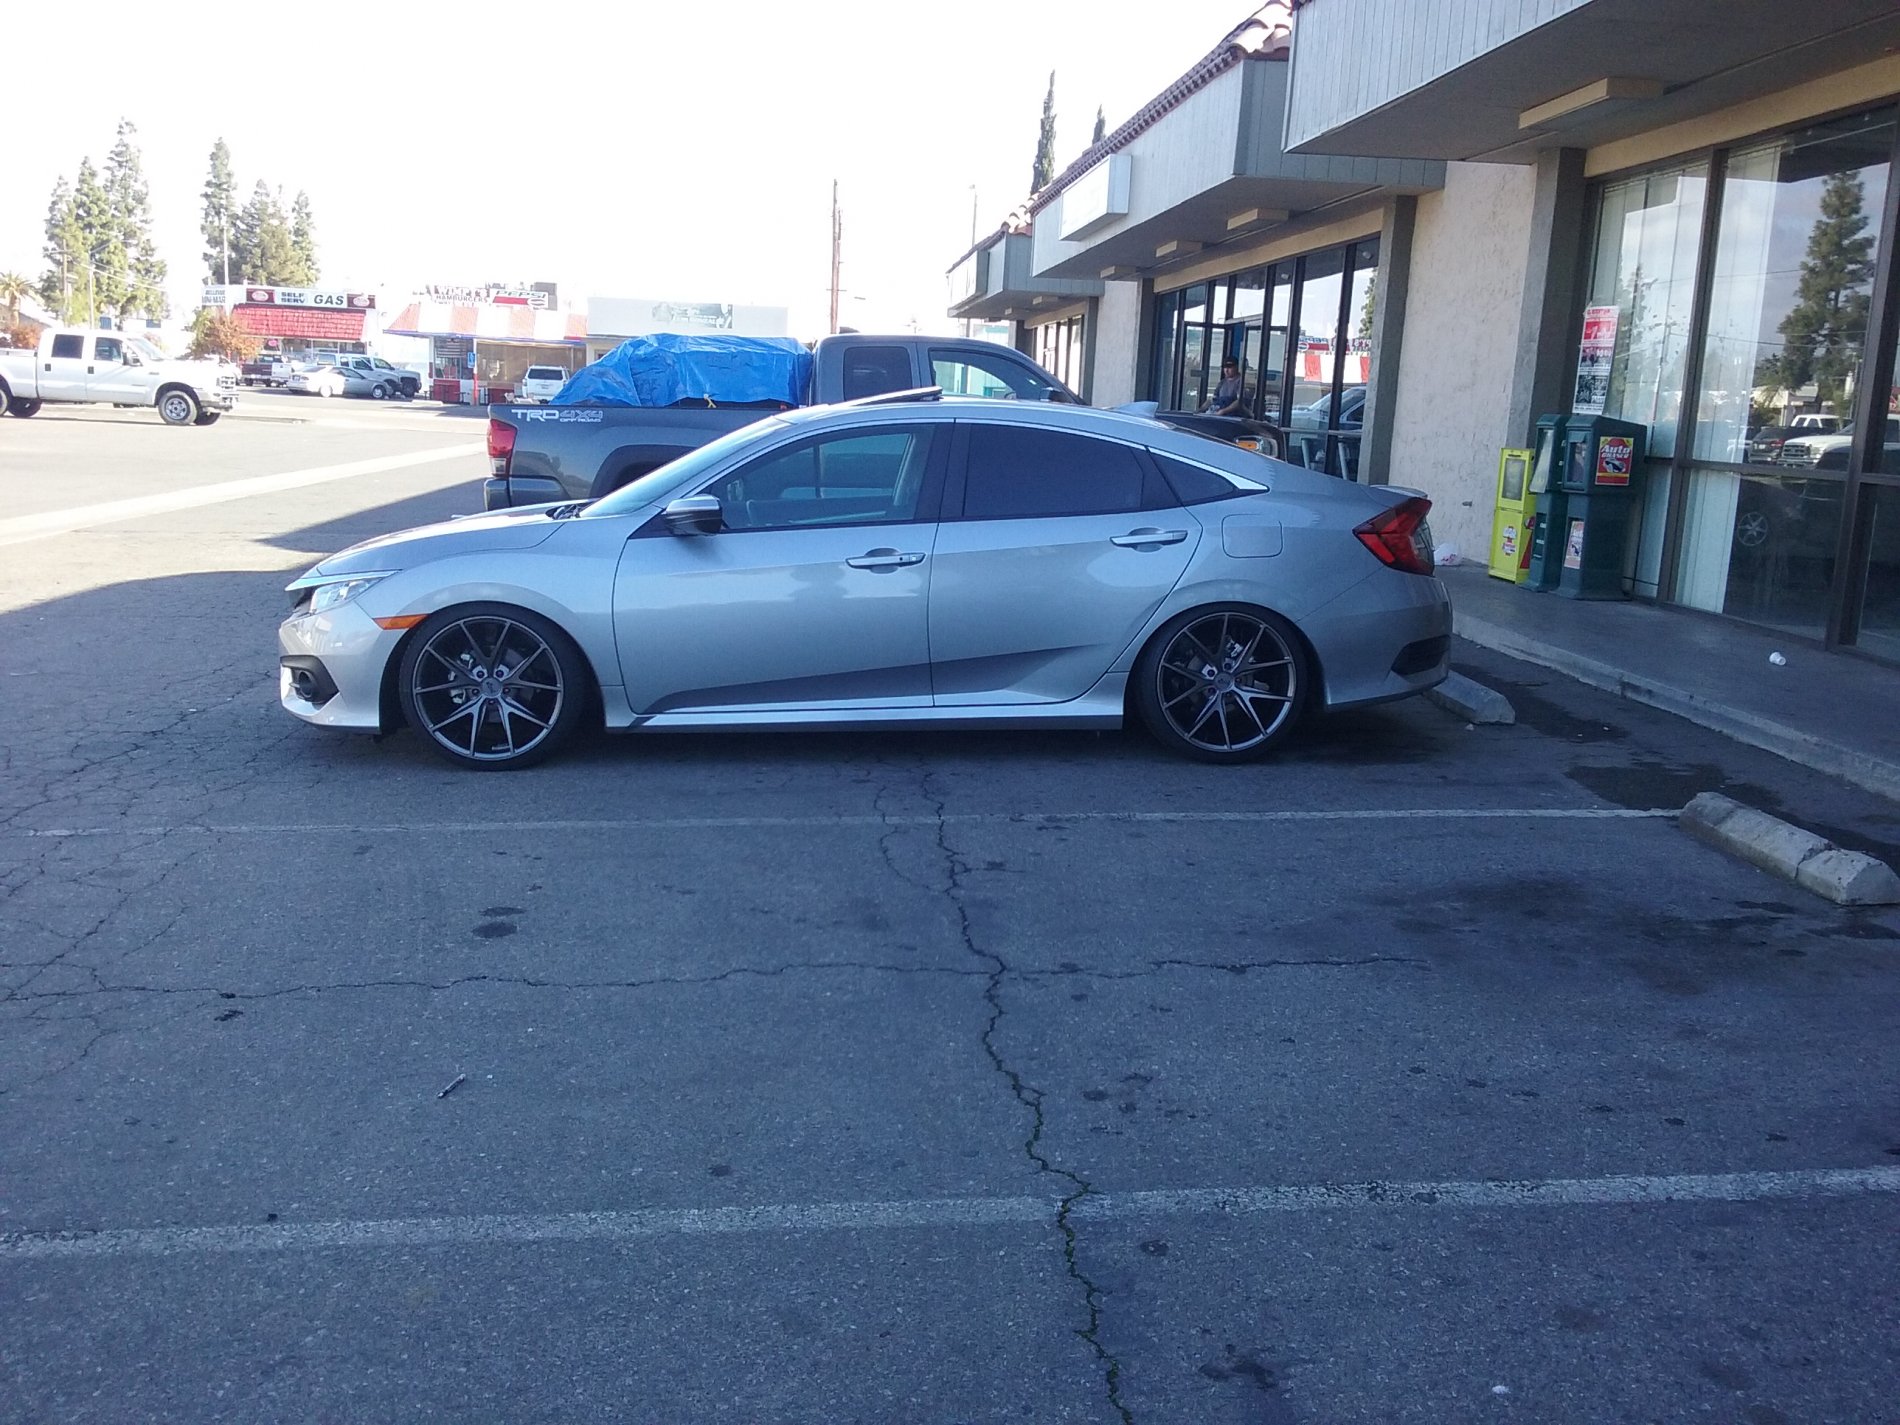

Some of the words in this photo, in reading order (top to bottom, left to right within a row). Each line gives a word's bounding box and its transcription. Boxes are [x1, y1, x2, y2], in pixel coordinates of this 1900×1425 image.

[495, 290, 547, 298] PEPSI
[313, 294, 345, 305] GAS
[511, 408, 559, 422] TRD
[1601, 444, 1630, 454] Auto
